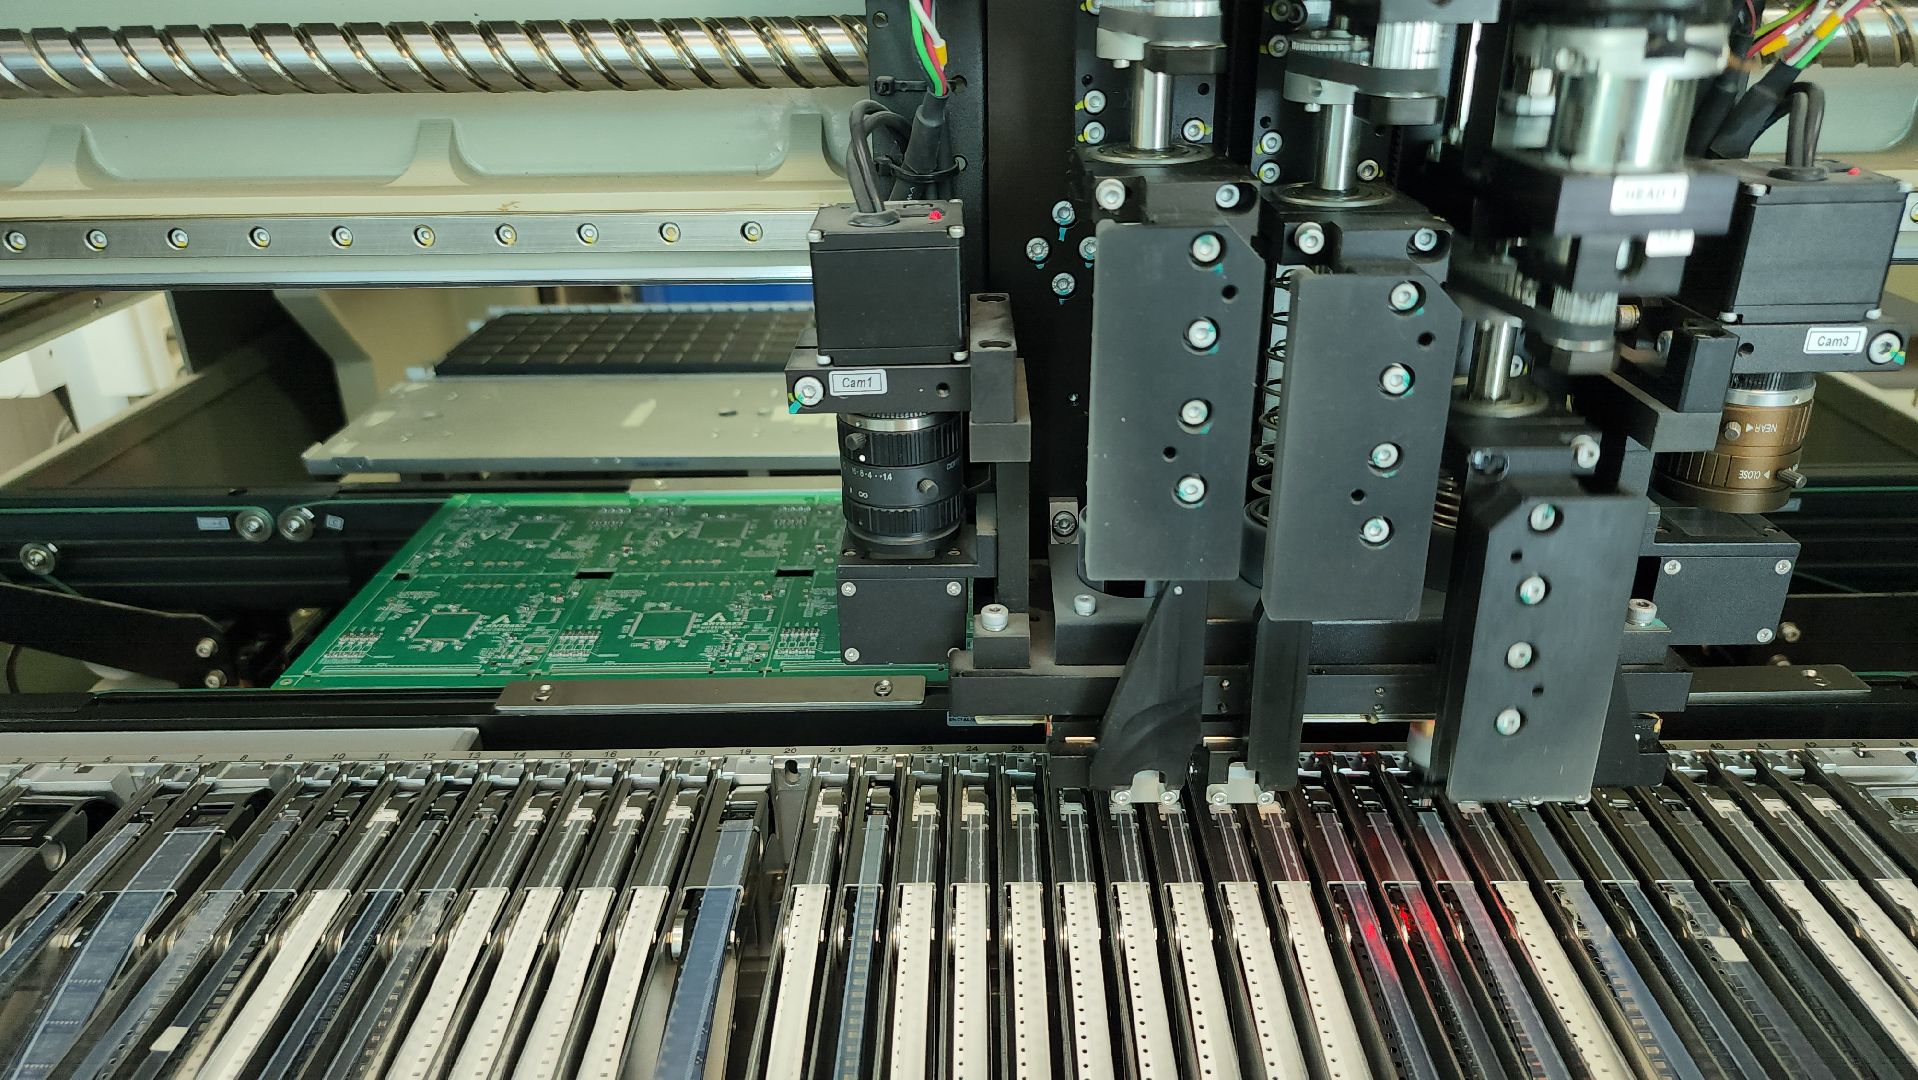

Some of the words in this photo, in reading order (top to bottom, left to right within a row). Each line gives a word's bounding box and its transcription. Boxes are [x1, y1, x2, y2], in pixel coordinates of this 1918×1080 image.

[1817, 335, 1850, 347] Cam3
[842, 376, 873, 388] Cam1
[1754, 423, 1777, 432] NEAR
[1738, 469, 1761, 480] CLOSE
[377, 752, 390, 760] 11
[423, 752, 437, 760] 12
[468, 751, 482, 759] 13
[513, 751, 527, 759] 14
[1011, 744, 1025, 752] 25
